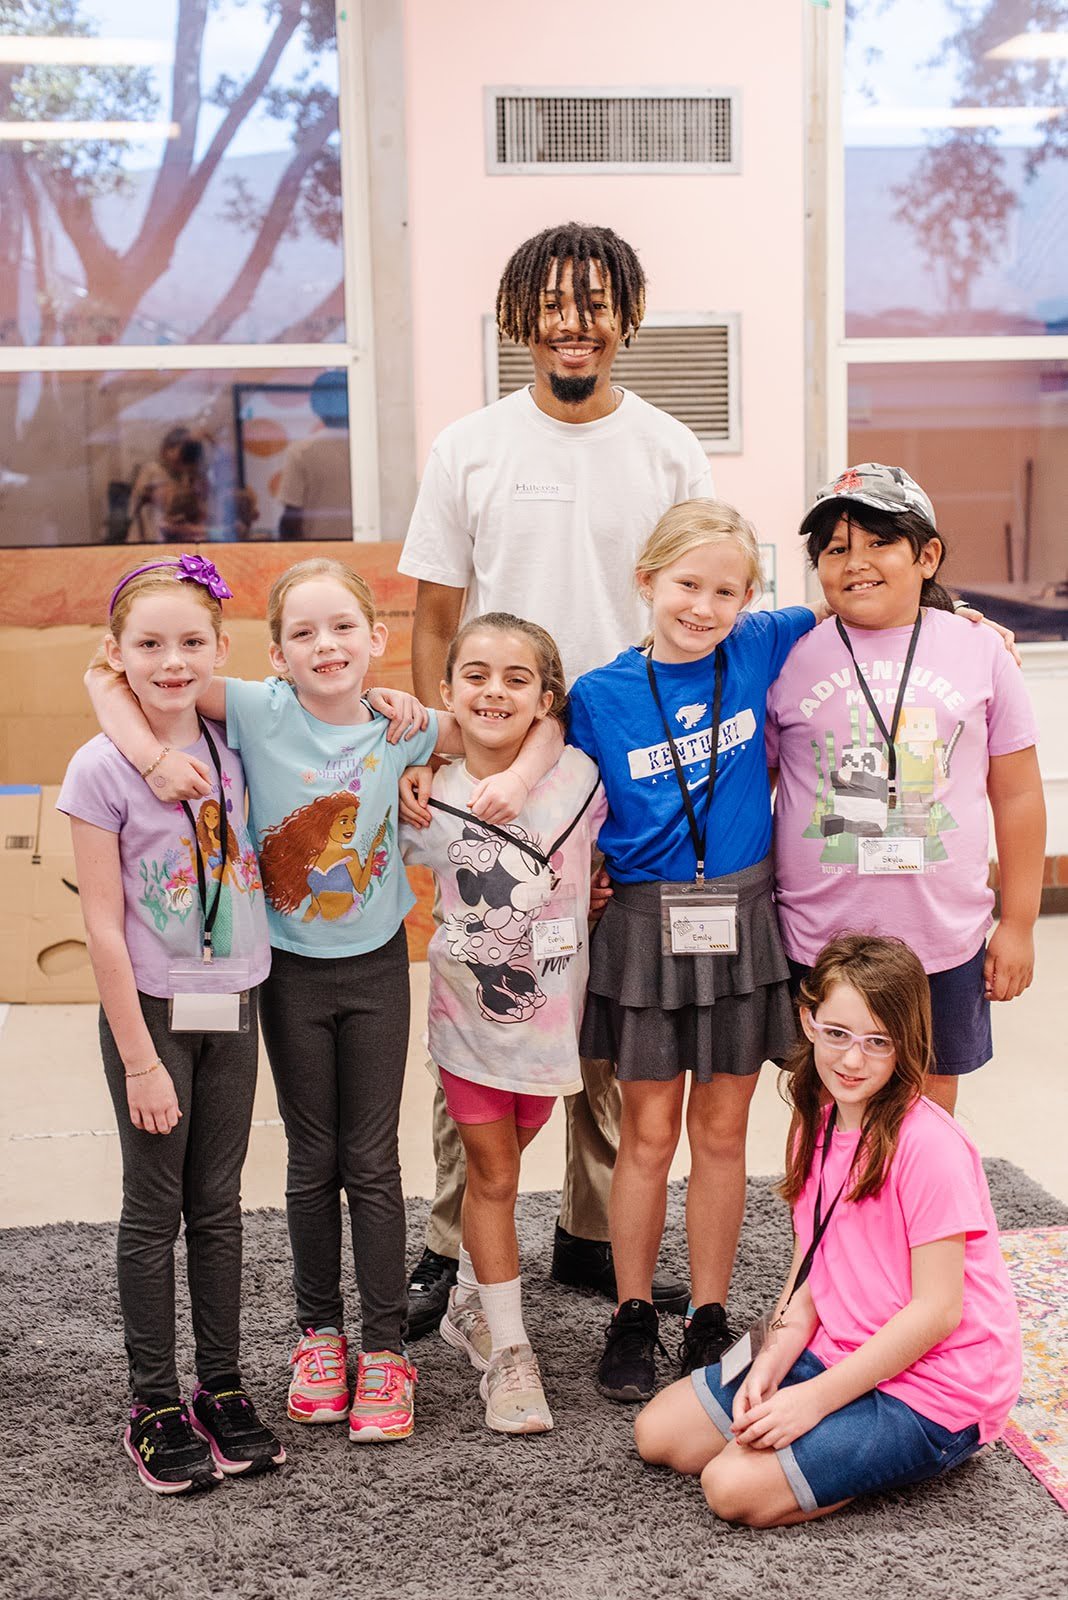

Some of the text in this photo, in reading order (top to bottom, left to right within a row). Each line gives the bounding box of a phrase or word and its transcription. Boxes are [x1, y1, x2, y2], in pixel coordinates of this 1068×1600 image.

[846, 687, 916, 705] MODE
[887, 844, 899, 853] 37
[692, 933, 712, 942] Emily
